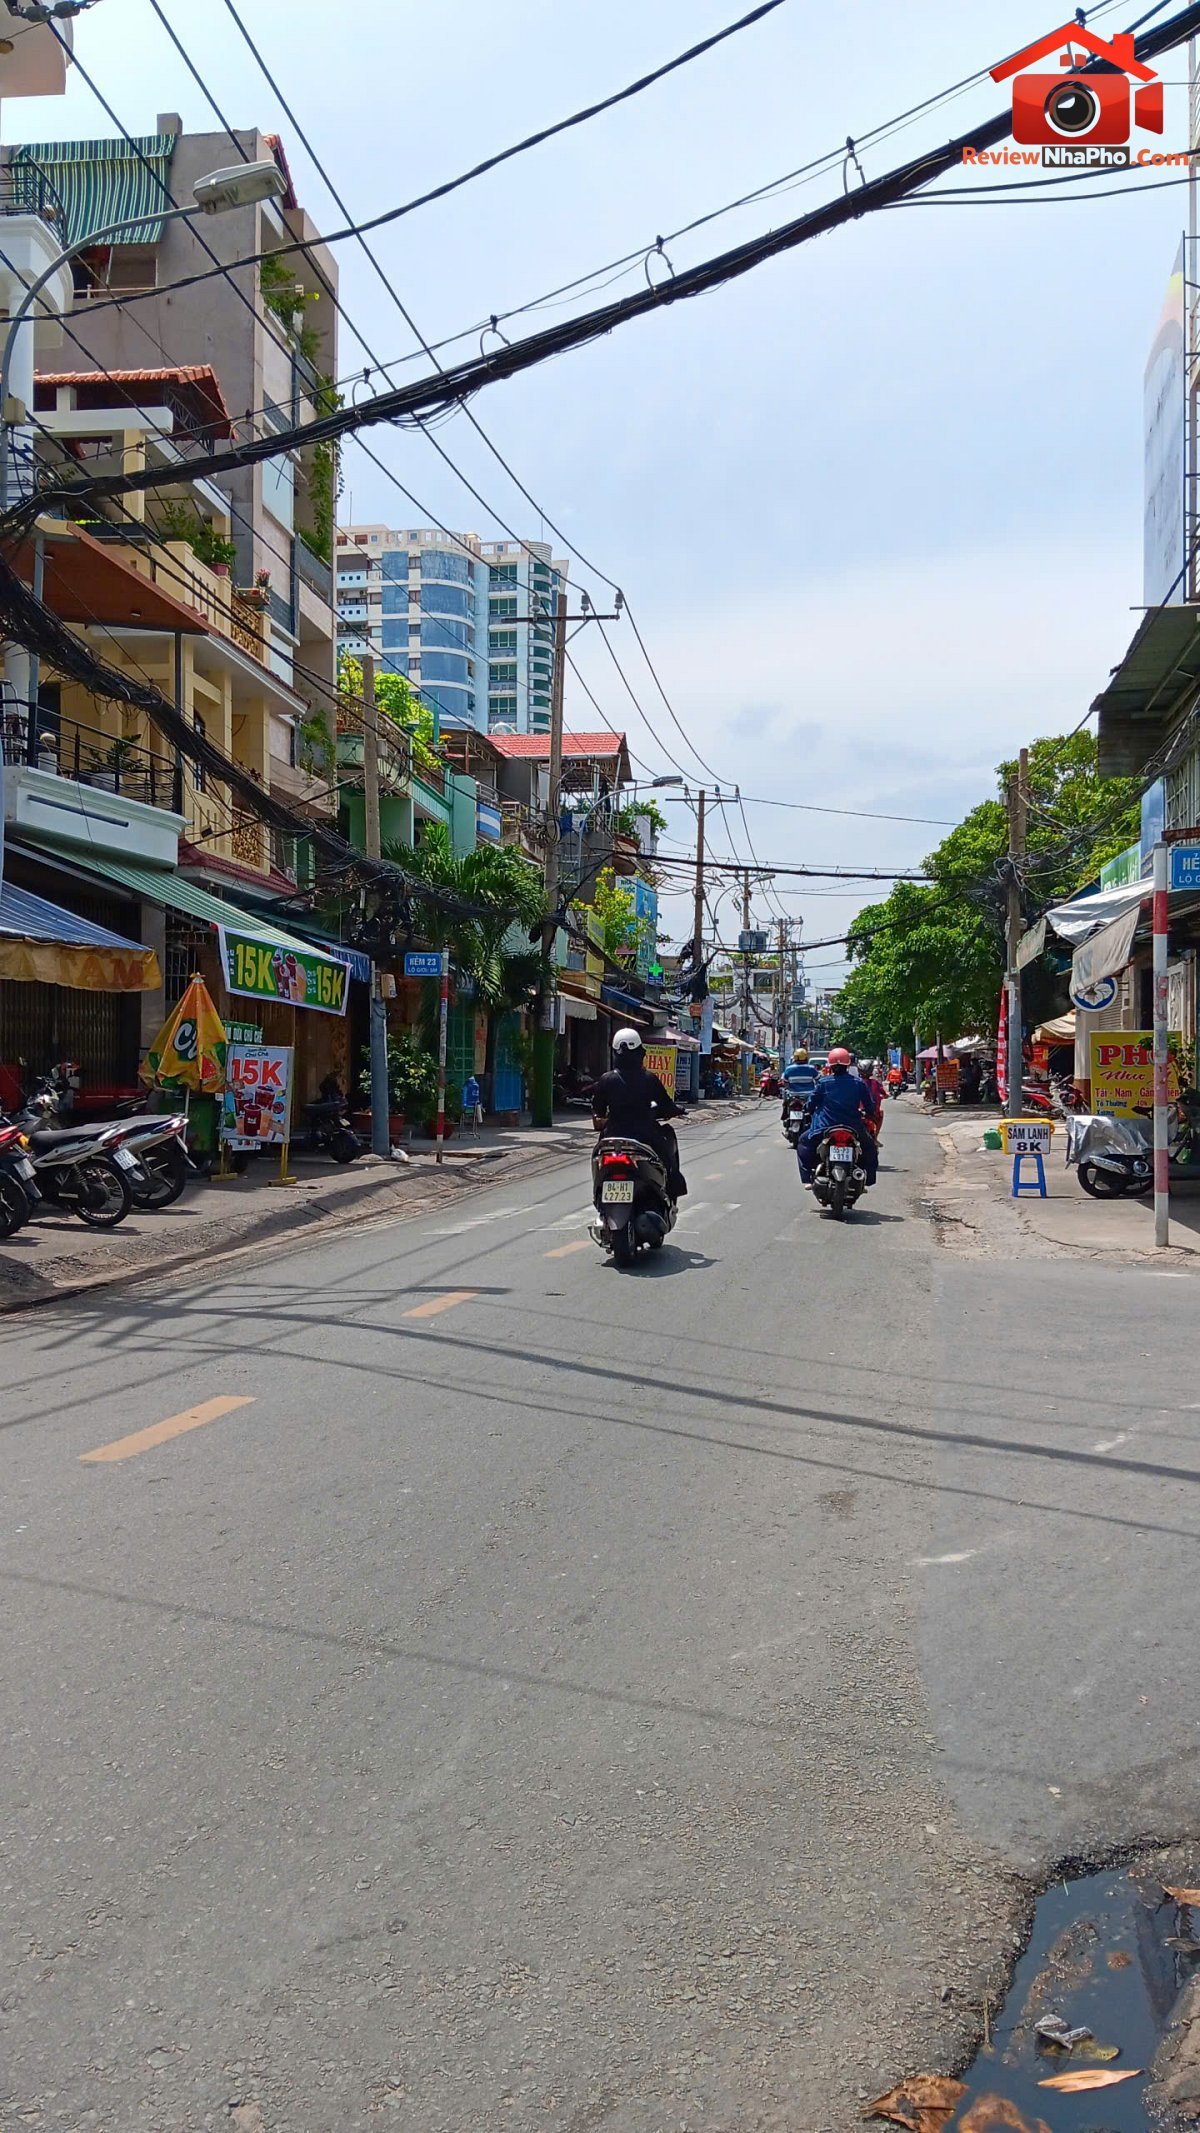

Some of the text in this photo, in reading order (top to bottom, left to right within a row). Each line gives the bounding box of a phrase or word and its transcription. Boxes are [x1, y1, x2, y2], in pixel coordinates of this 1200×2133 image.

[236, 944, 275, 991] 15K
[427, 958, 437, 966] 23
[316, 965, 344, 1007] 15K
[232, 1059, 283, 1086] 15K
[1008, 1125, 1025, 1139] SÂM
[1016, 1142, 1042, 1151] 8K
[607, 1183, 628, 1191] 84-H1
